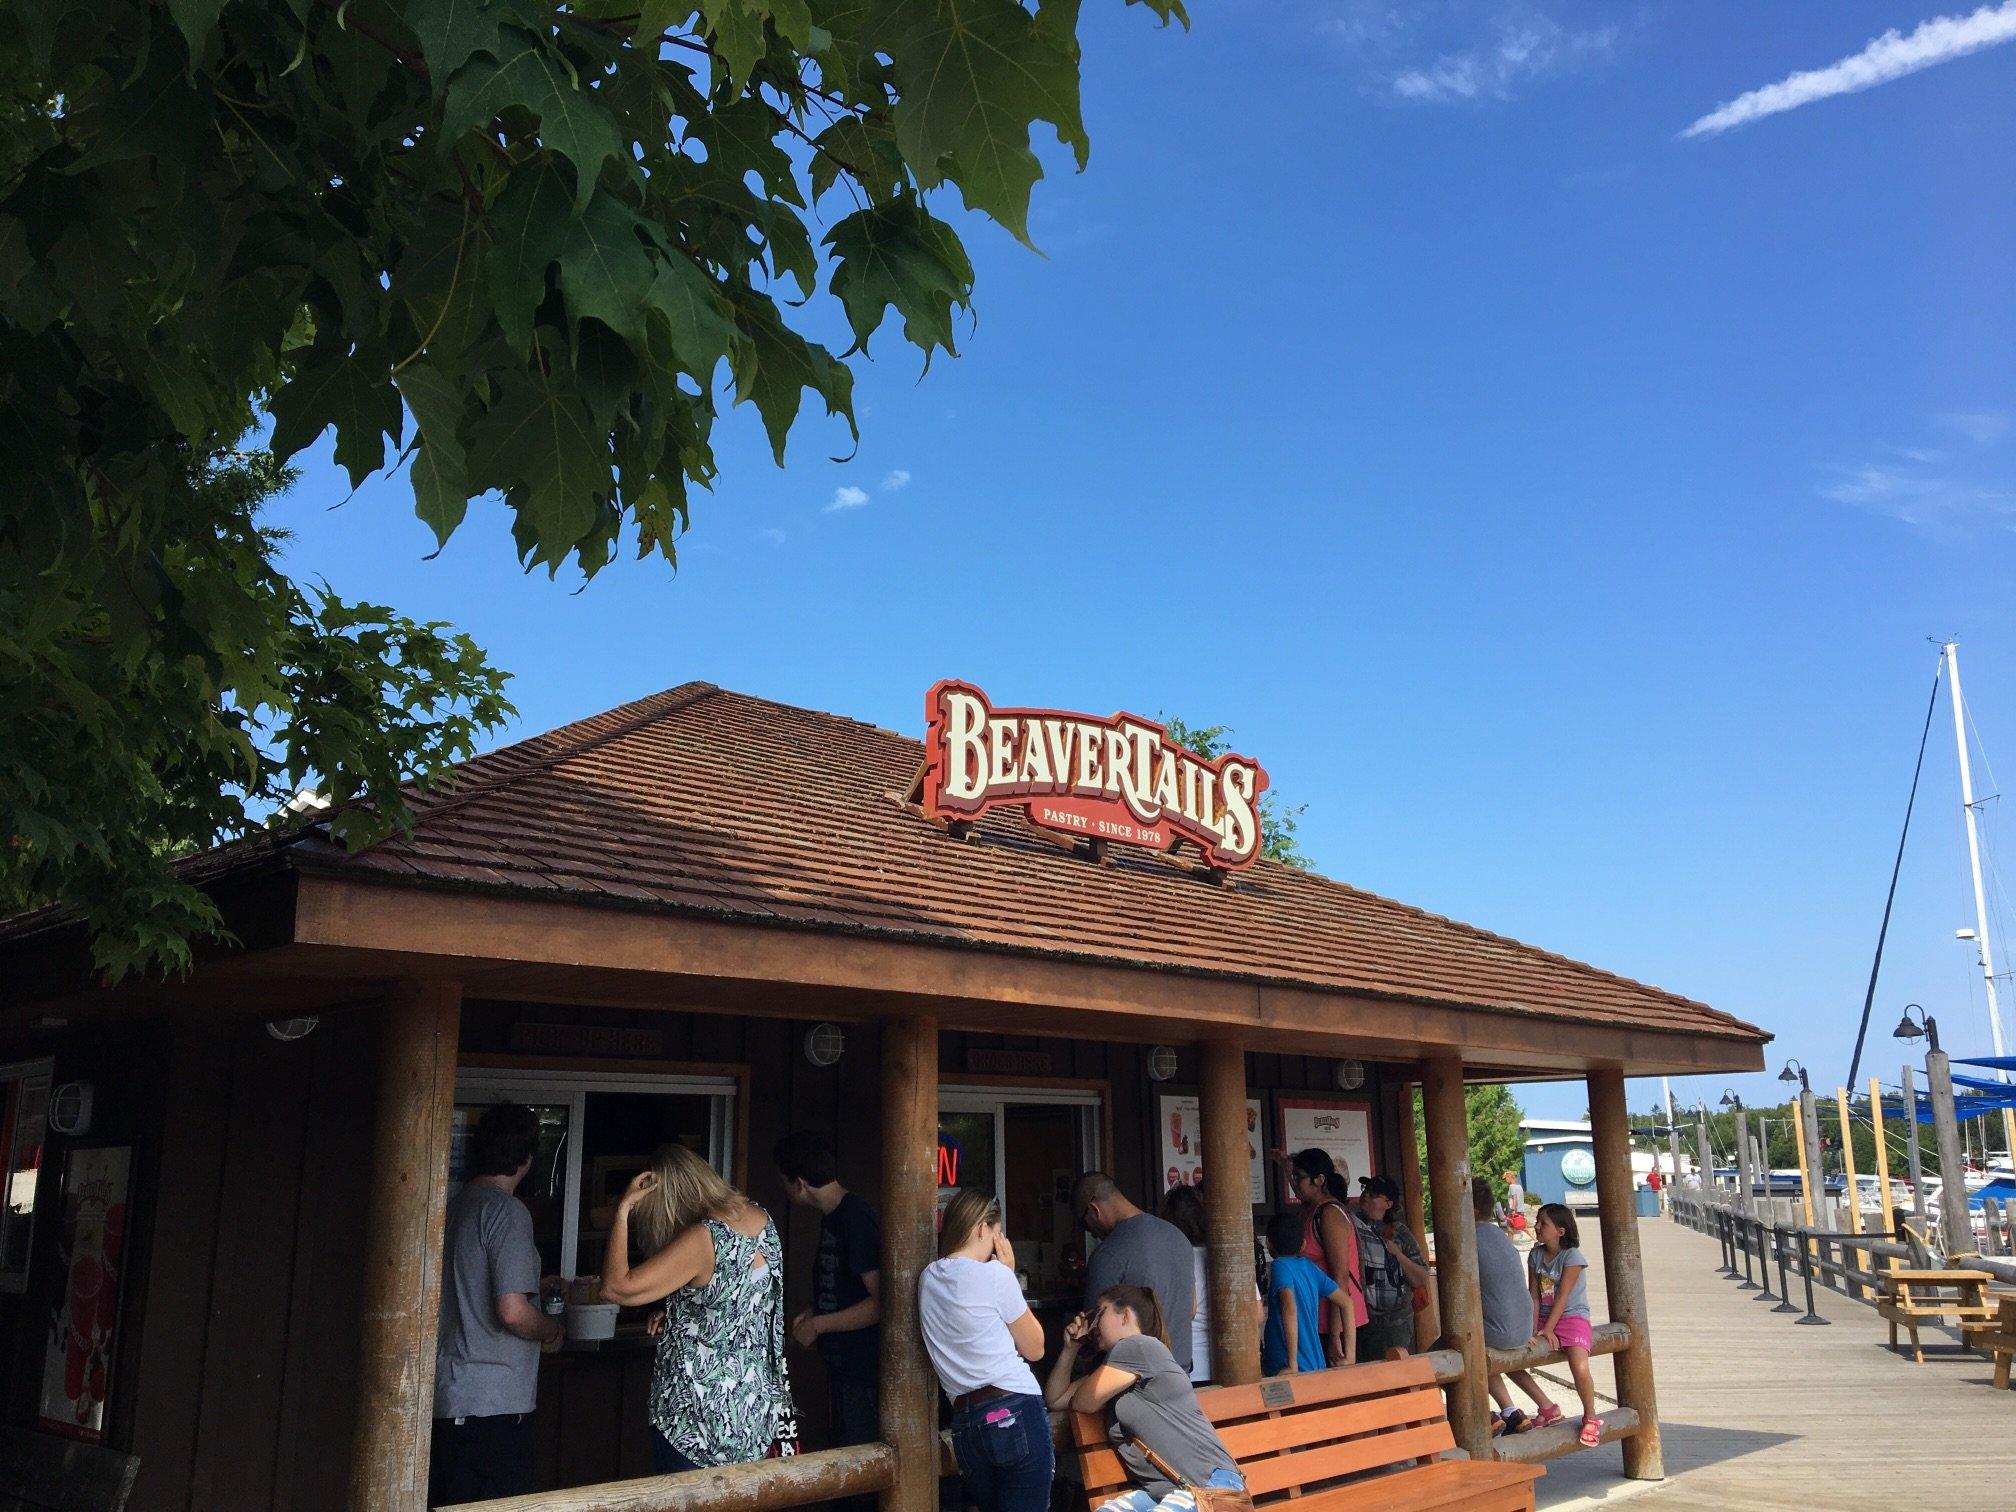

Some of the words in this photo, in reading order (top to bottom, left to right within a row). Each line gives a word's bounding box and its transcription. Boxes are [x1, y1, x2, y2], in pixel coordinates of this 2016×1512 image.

[1043, 808, 1089, 829] PASTRY
[1098, 820, 1132, 838] SINCE
[1136, 828, 1161, 844] 1978
[937, 1146, 958, 1186] N
